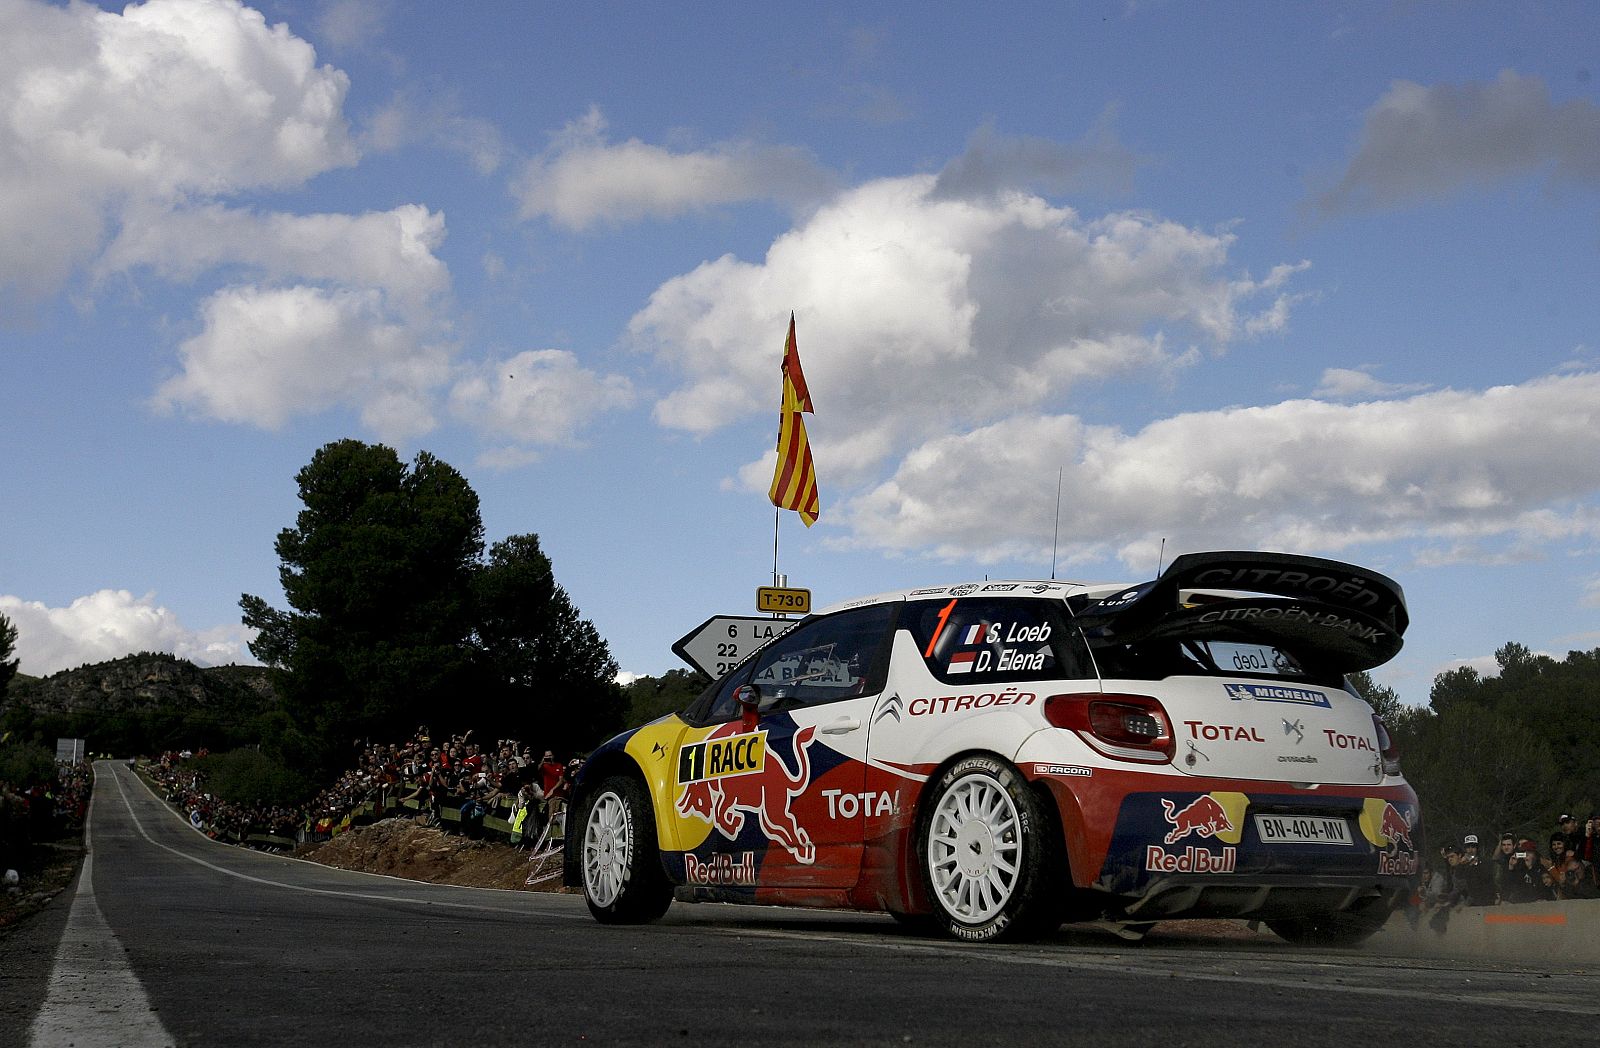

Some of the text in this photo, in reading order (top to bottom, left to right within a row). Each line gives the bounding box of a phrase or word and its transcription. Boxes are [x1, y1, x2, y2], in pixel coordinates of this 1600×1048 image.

[764, 594, 804, 607] T-730
[728, 624, 738, 639] 6
[753, 625, 774, 639] LA
[924, 599, 958, 658] 1
[986, 621, 1052, 644] S. Loeb
[1319, 615, 1386, 644] BANK
[717, 643, 738, 658] 22
[975, 649, 1045, 673] D. Elena
[1254, 686, 1324, 703] MICHELIN
[1184, 720, 1265, 743] TOTAL
[1322, 729, 1376, 752] TOTAL
[688, 737, 759, 780] 1 RACC
[953, 759, 1000, 776] MICHELIN
[1264, 817, 1345, 841] BN-404-MV
[685, 851, 755, 884] Red Bull
[1146, 845, 1237, 874] Red Bull
[951, 923, 998, 940] MICHELIN
